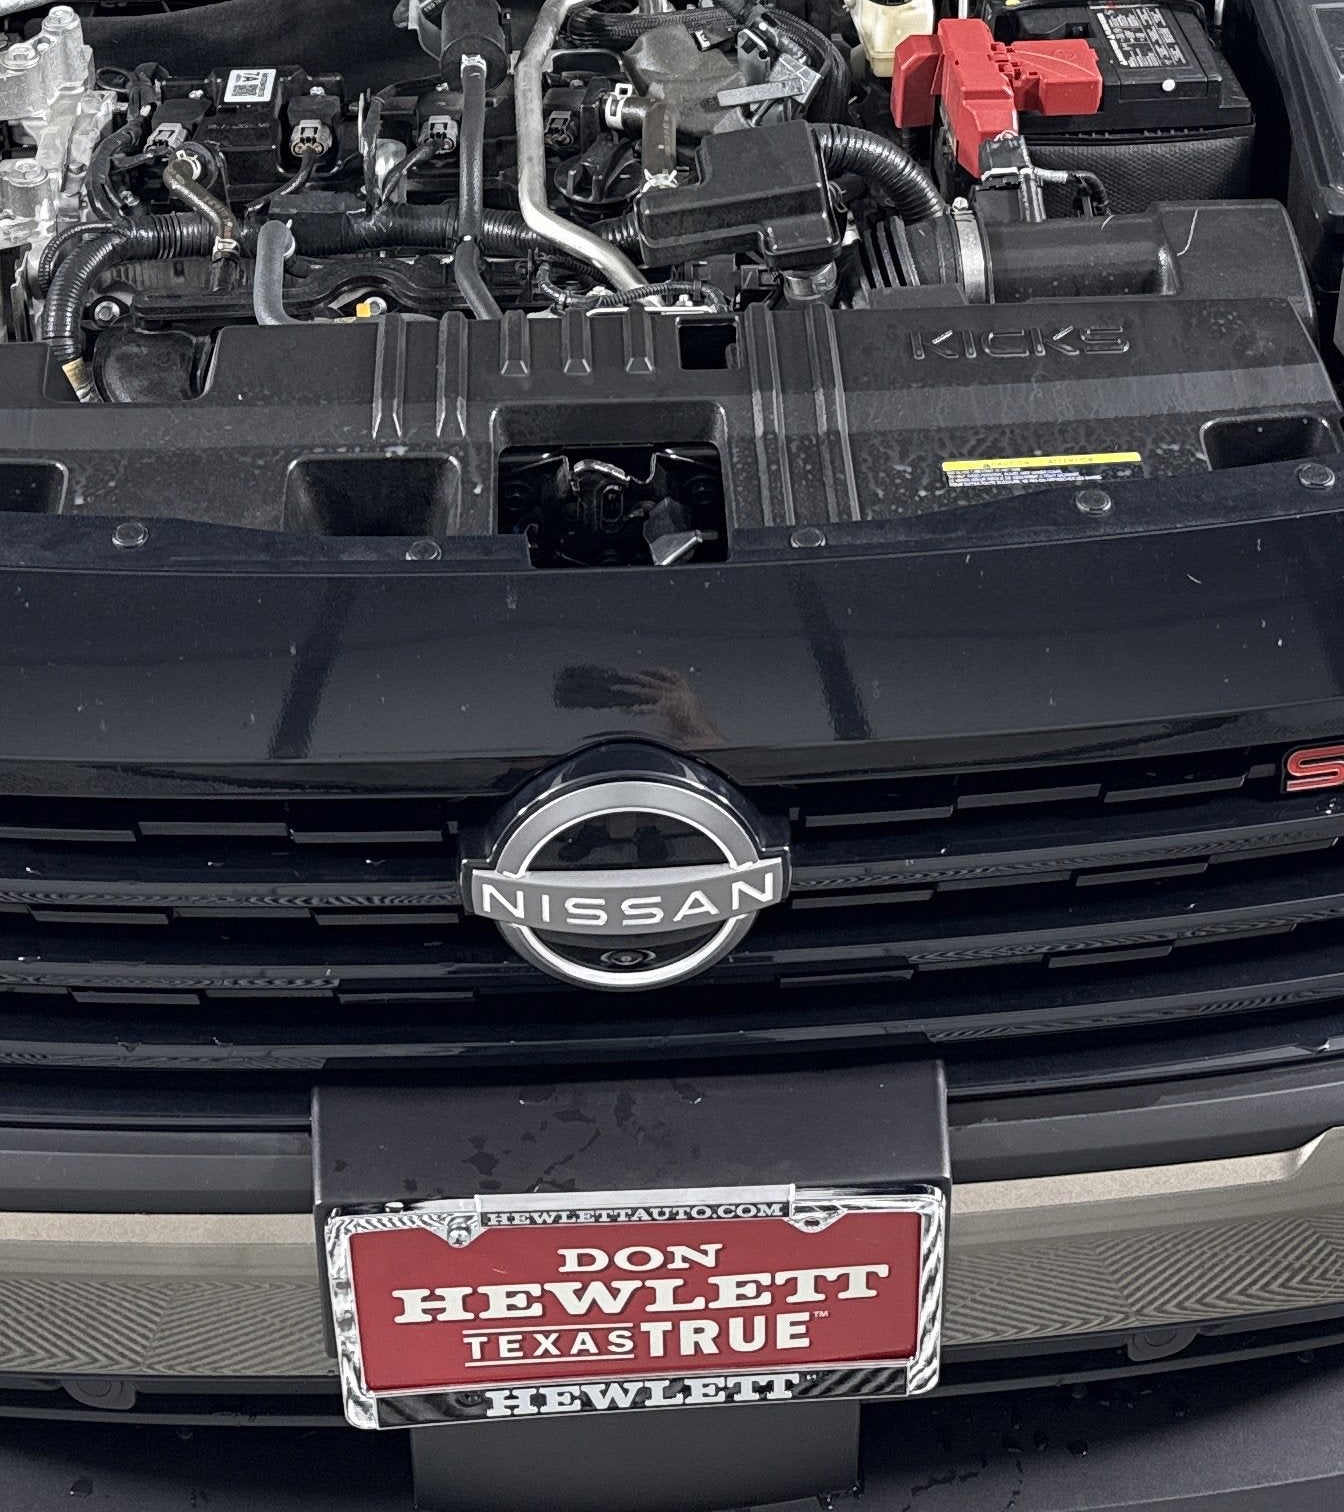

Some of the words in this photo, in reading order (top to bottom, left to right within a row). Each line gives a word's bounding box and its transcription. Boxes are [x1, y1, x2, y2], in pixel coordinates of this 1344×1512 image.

[910, 326, 1130, 360] KICKS
[481, 872, 775, 927] NISSAN
[486, 1203, 783, 1226] HEWLETTAUTO.COM
[558, 1243, 723, 1273] DON
[392, 1264, 889, 1324] HEWLETT
[485, 1373, 800, 1418] HEWLETT
